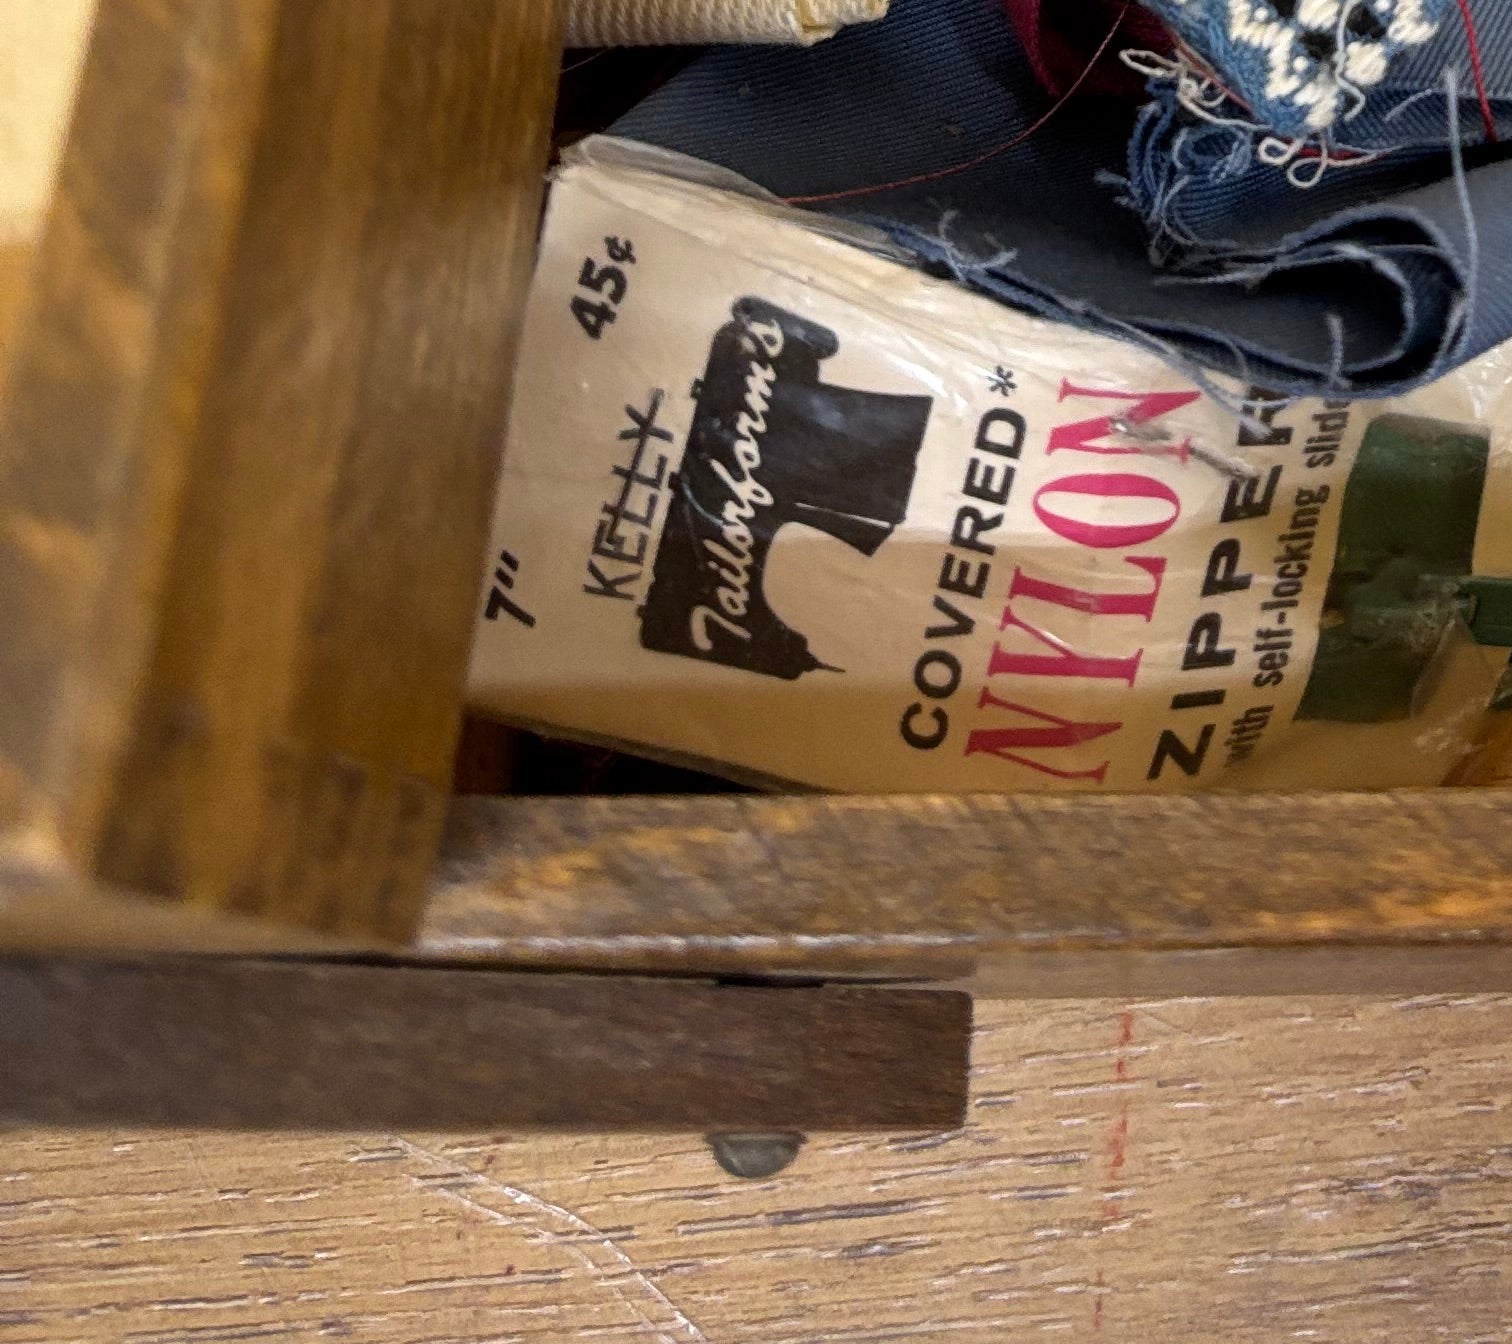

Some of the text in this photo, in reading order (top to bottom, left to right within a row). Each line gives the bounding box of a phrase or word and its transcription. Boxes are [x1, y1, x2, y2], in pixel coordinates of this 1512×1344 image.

[569, 234, 636, 341] 45¢
[583, 390, 675, 602] KELLY
[900, 406, 1028, 750] COVERED
[963, 376, 1202, 784] NYLON
[1146, 386, 1295, 781] ZIPPER
[1252, 483, 1331, 689] self-locking
